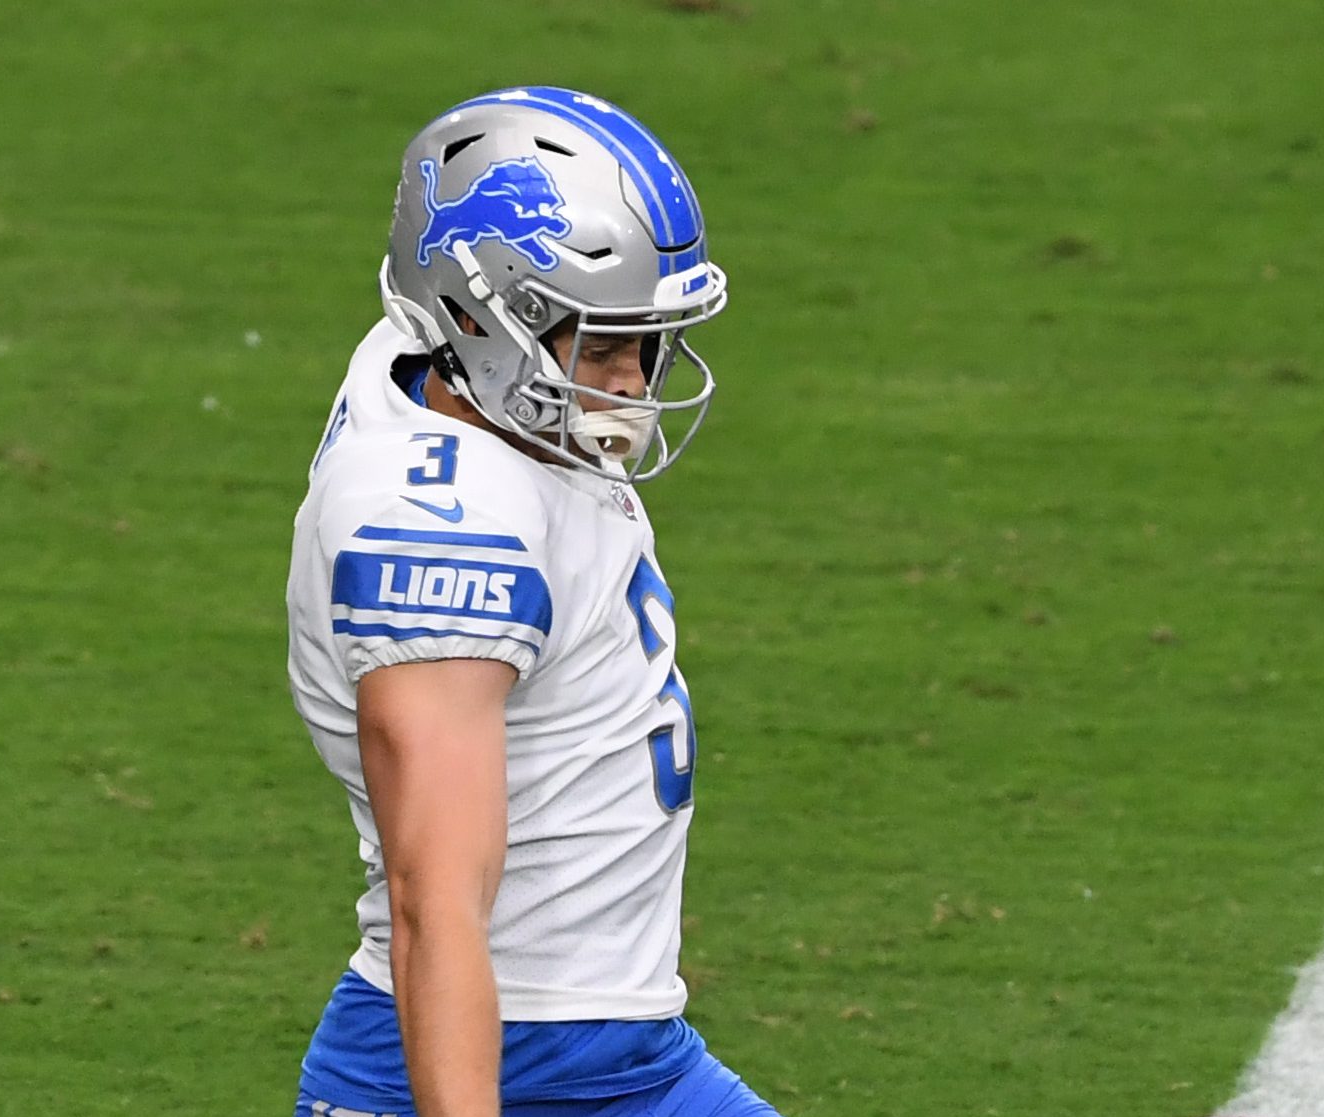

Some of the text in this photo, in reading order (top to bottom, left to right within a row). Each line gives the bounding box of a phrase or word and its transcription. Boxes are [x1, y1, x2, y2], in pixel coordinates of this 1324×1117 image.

[407, 433, 460, 486] 3
[379, 563, 516, 613] LIONS
[626, 553, 697, 814] 3
